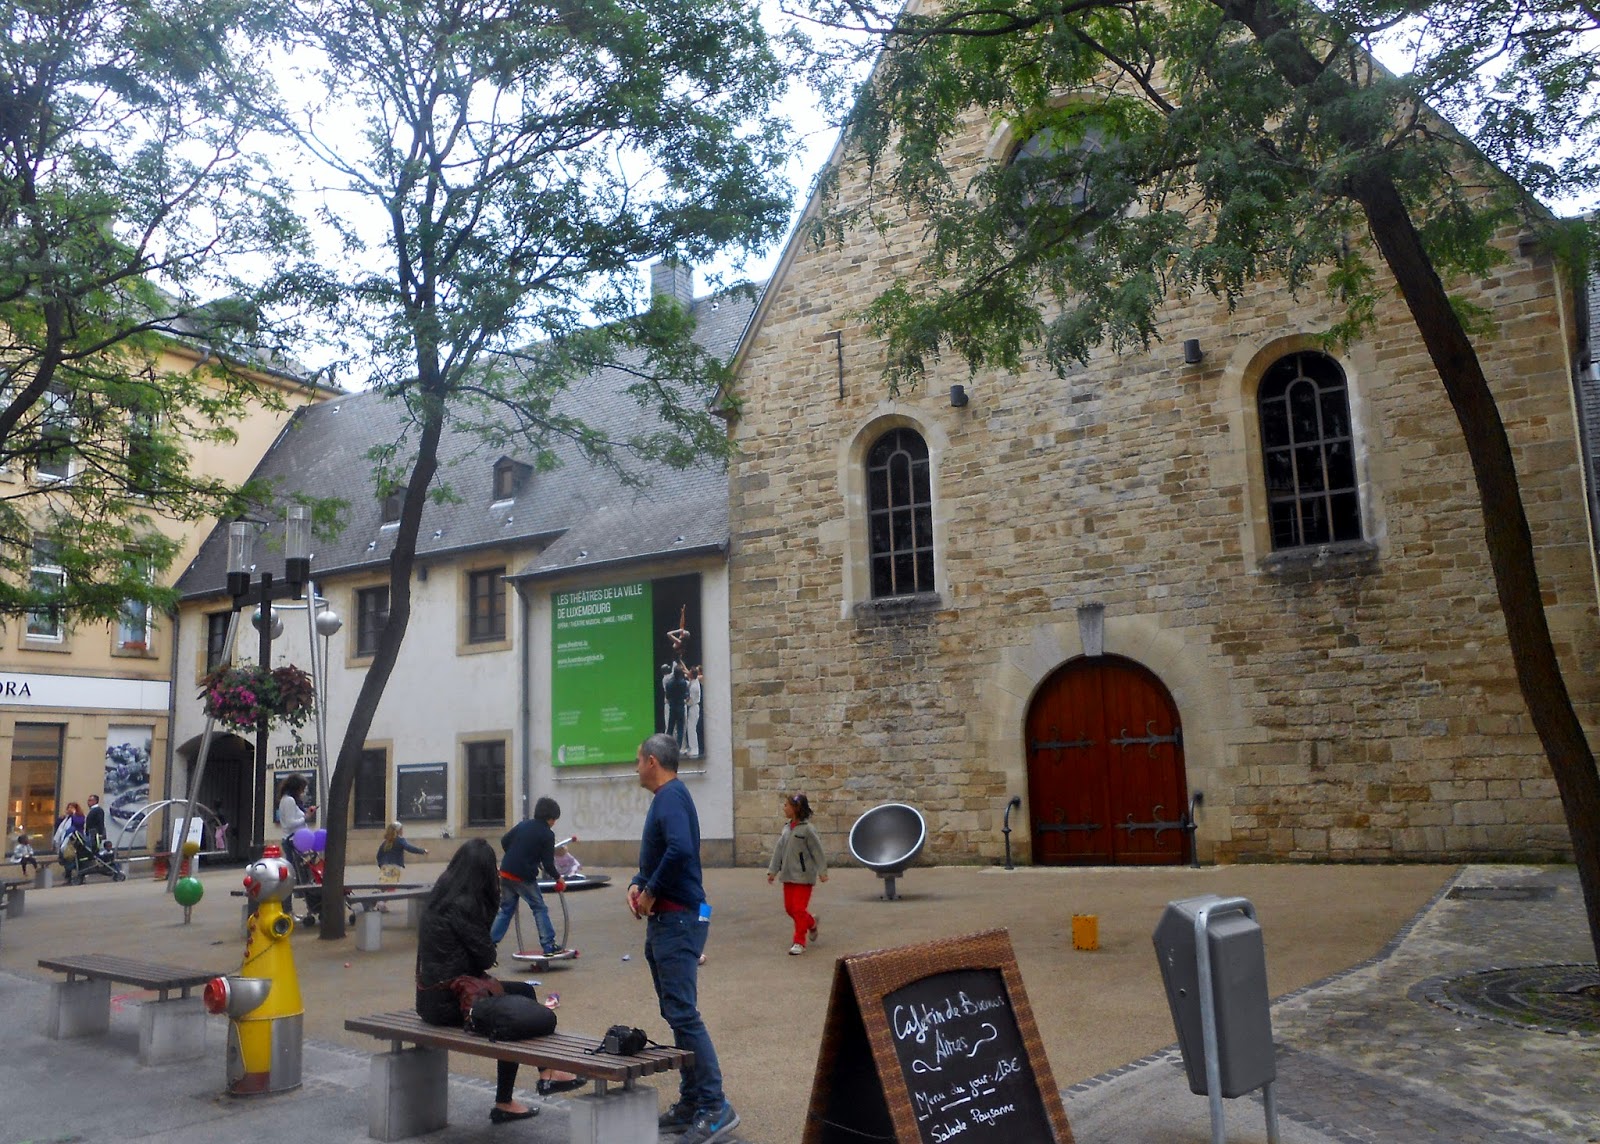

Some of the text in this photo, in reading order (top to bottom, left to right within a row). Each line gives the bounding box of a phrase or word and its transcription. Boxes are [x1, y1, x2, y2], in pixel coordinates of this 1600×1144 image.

[557, 594, 569, 606] LES
[603, 588, 613, 600] DE
[613, 586, 623, 598] LA
[623, 584, 643, 596] VILLE
[557, 602, 611, 619] DE LUXEMBOURG
[0, 681, 32, 697] RA
[275, 757, 319, 770] CAPUCINS
[946, 998, 962, 1020] de
[936, 1028, 969, 1063] Aires
[914, 1091, 946, 1115] Menu
[951, 1082, 966, 1096] du
[931, 1103, 1016, 1143] Salade Paysanne
